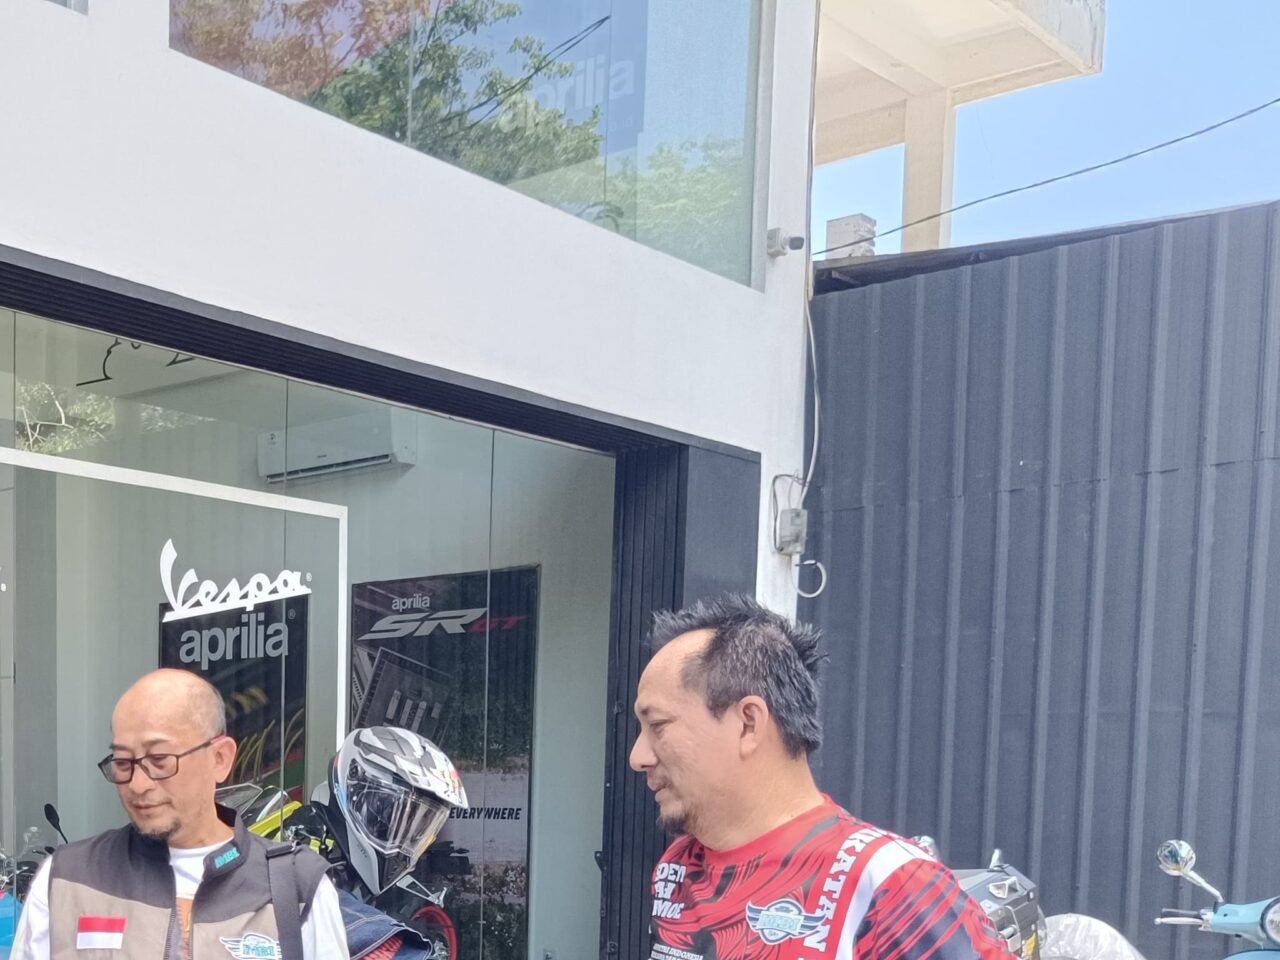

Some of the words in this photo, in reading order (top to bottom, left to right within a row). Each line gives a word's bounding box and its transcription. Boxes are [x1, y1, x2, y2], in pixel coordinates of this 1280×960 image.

[160, 538, 312, 623] Vespa
[391, 593, 431, 612] aprilia
[179, 612, 290, 670] aprilia
[357, 607, 488, 641] SR
[449, 807, 522, 821] EVERYWHERE
